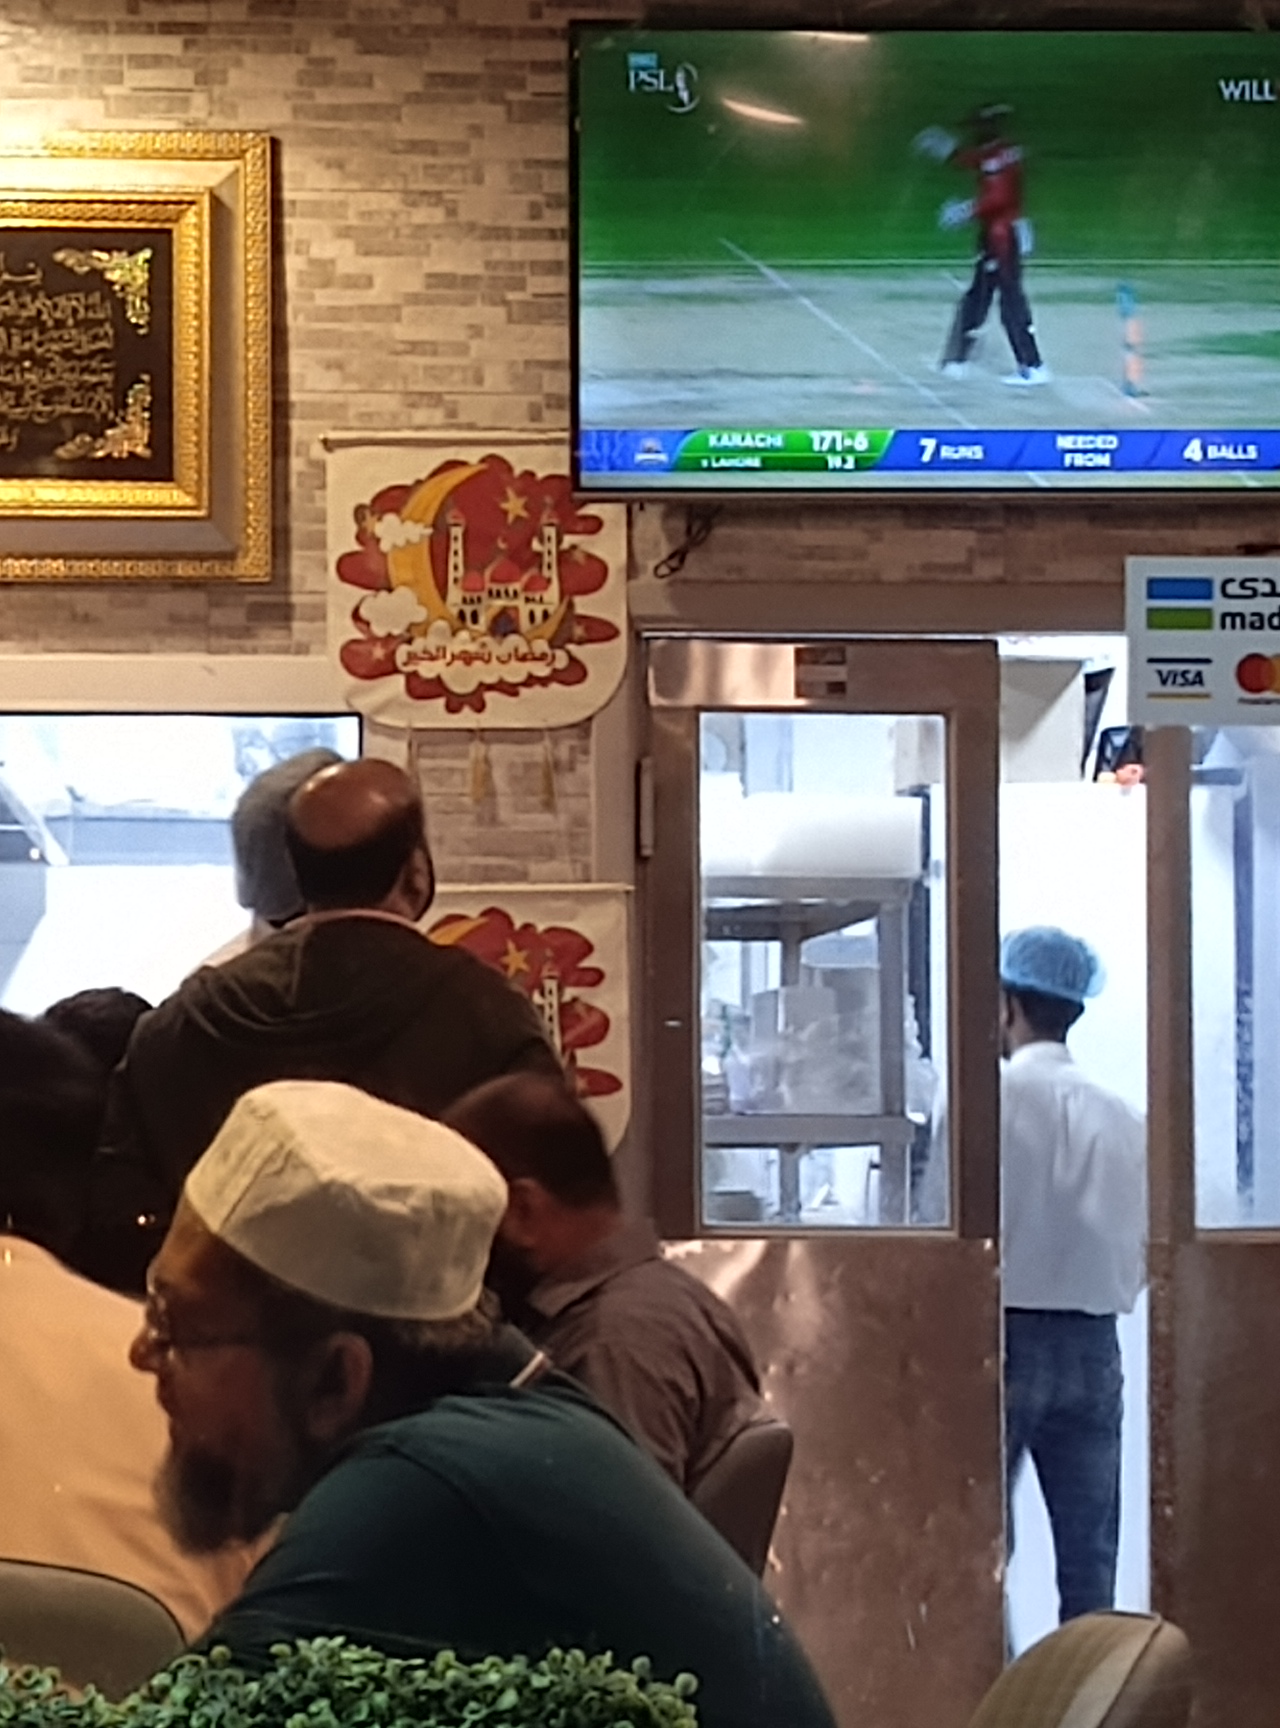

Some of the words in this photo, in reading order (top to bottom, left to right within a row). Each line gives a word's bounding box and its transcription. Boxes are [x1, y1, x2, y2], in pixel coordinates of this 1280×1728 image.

[627, 69, 675, 91] PSL
[708, 433, 784, 448] KARACHI
[1056, 434, 1118, 450] NEEDED
[919, 438, 938, 463] 7
[939, 445, 985, 460] RUNS
[1183, 438, 1202, 463] 4
[1207, 445, 1258, 460] BALLS
[1063, 452, 1112, 468] FROM
[1155, 669, 1205, 687] VISA
